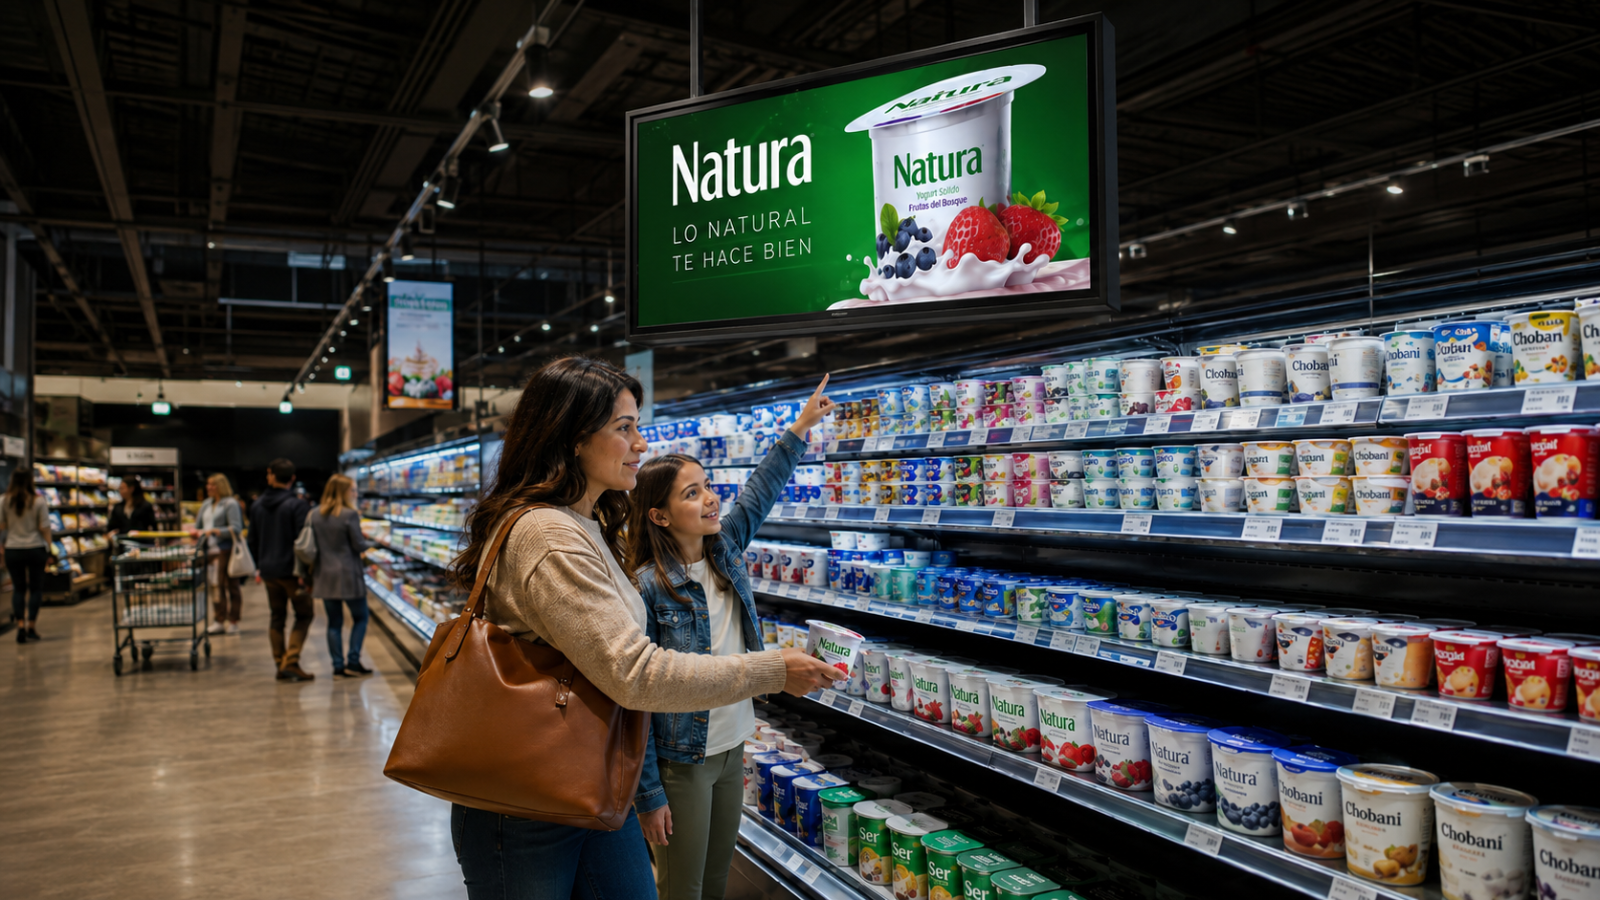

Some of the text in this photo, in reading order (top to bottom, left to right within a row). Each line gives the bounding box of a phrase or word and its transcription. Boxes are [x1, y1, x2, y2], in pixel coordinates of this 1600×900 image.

[885, 76, 1012, 114] Natura
[672, 134, 812, 206] Natura
[894, 147, 982, 189] Natura
[908, 196, 968, 212] Frutas del Bosque
[916, 189, 938, 201] Yogurt
[673, 206, 812, 245] LO NATURAL
[672, 237, 811, 272] TE HACE BIEN
[819, 637, 851, 658] Natura
[950, 684, 980, 705] Natura
[992, 695, 1025, 718] Natura
[1040, 708, 1076, 732] Natura
[1093, 723, 1130, 747] Natura
[1152, 740, 1190, 766] Natura
[1215, 760, 1258, 787] Natura
[1279, 780, 1323, 806] hobani
[1345, 800, 1402, 827] Chobani
[859, 826, 880, 843] Ser
[1441, 822, 1503, 851] Chobani
[892, 842, 913, 861] Ser
[928, 860, 951, 881] Ser
[964, 880, 990, 900] Ser
